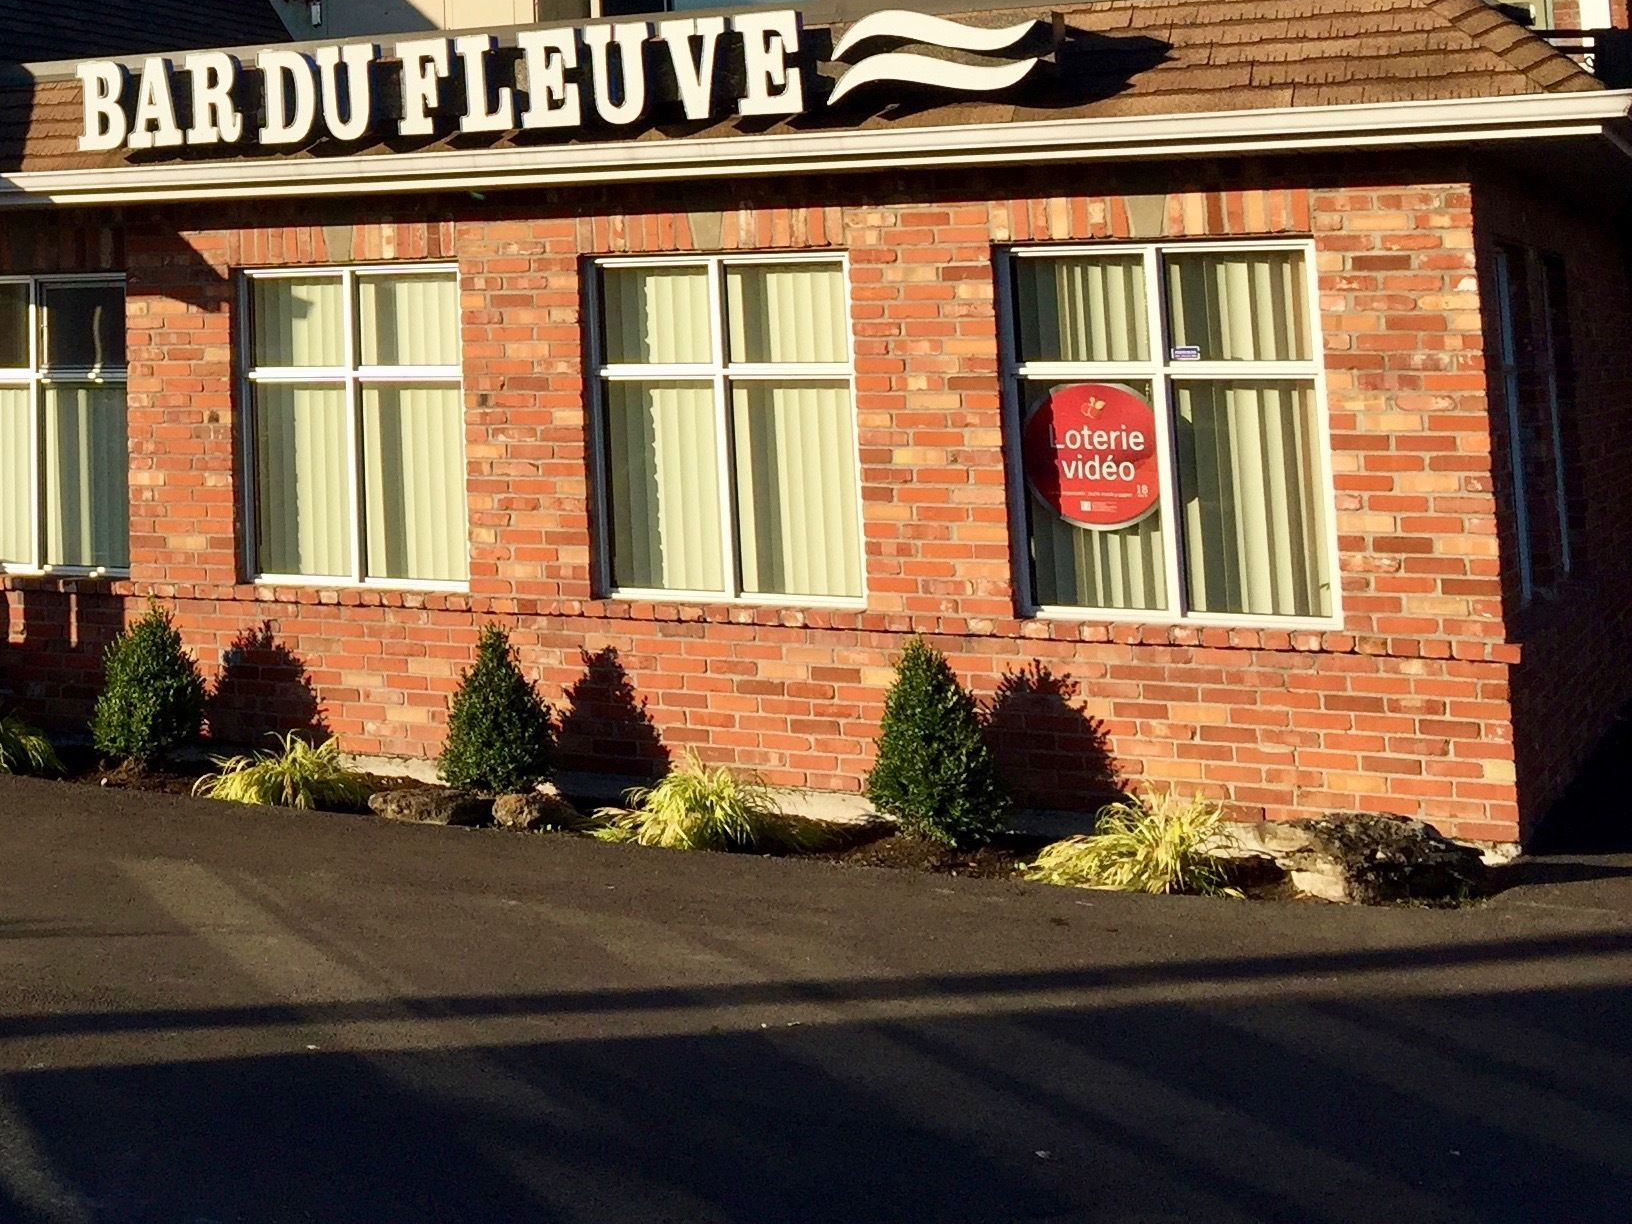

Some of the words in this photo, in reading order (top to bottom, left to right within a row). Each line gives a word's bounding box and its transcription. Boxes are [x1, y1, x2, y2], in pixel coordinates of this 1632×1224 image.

[76, 51, 243, 152] BAR
[256, 42, 375, 146] DU
[395, 8, 805, 136] FLEUVE
[1049, 423, 1145, 451] Loterie
[1061, 453, 1135, 481] vidéo
